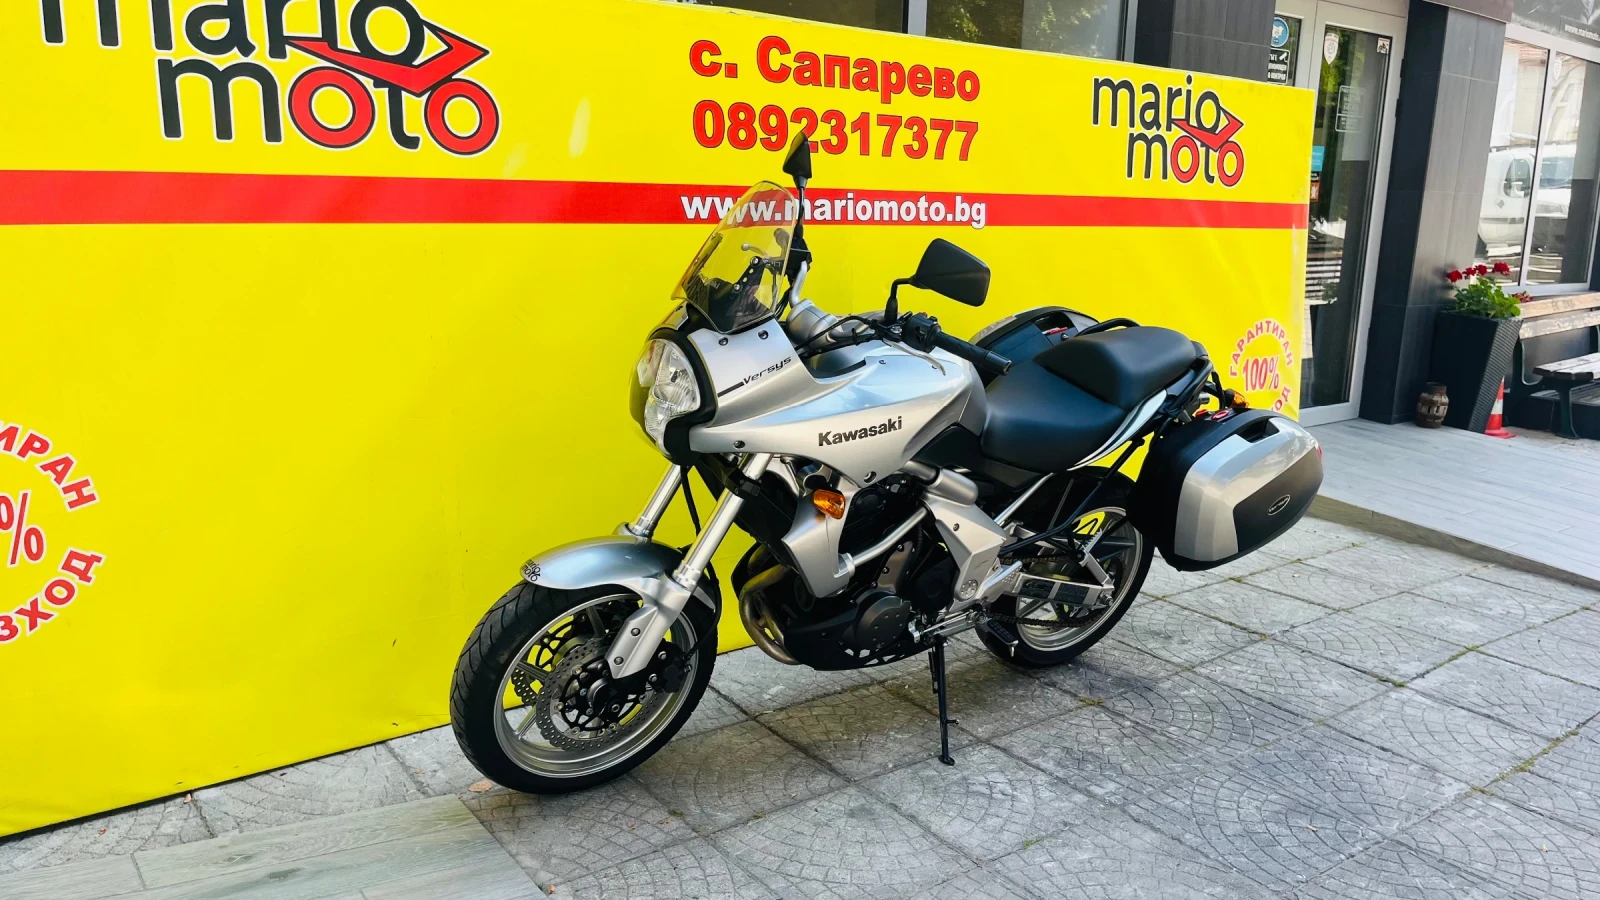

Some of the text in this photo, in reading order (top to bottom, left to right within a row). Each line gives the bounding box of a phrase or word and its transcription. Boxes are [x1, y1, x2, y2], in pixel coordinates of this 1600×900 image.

[689, 35, 981, 104] с. Сапарево
[160, 58, 499, 155] moto
[692, 100, 979, 161] 0892317377
[1092, 75, 1222, 133] mario
[1127, 130, 1245, 187] moto
[680, 193, 987, 228] www.mariomoto.bg
[743, 356, 792, 385] Versys
[1229, 320, 1293, 377] ГАРАНТИРАН
[1242, 356, 1280, 392] 100%
[818, 416, 903, 447] Kawasaki
